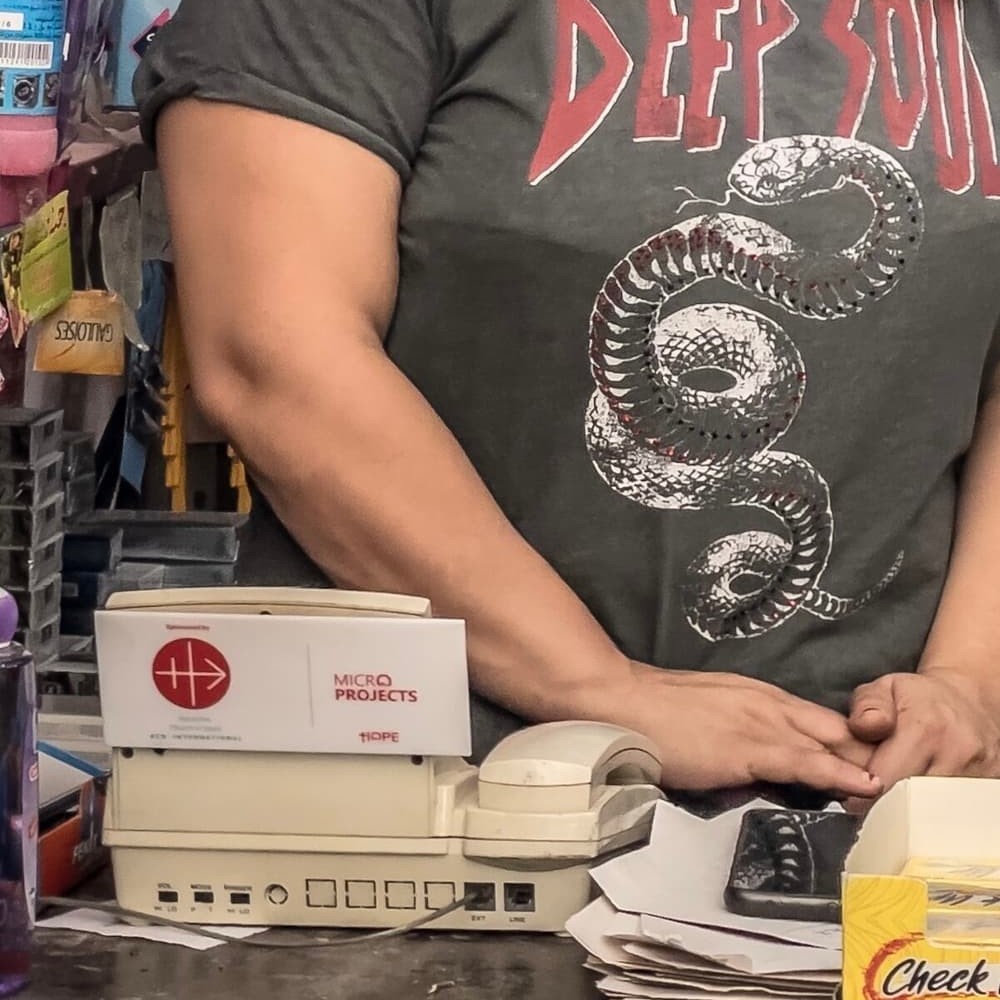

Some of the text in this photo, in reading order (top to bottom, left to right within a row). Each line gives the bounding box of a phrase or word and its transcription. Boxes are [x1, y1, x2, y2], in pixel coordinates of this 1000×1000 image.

[55, 320, 113, 343] GAULOISES
[334, 673, 392, 687] MICRO
[335, 689, 418, 702] PROJECTS
[883, 957, 991, 997] Check
